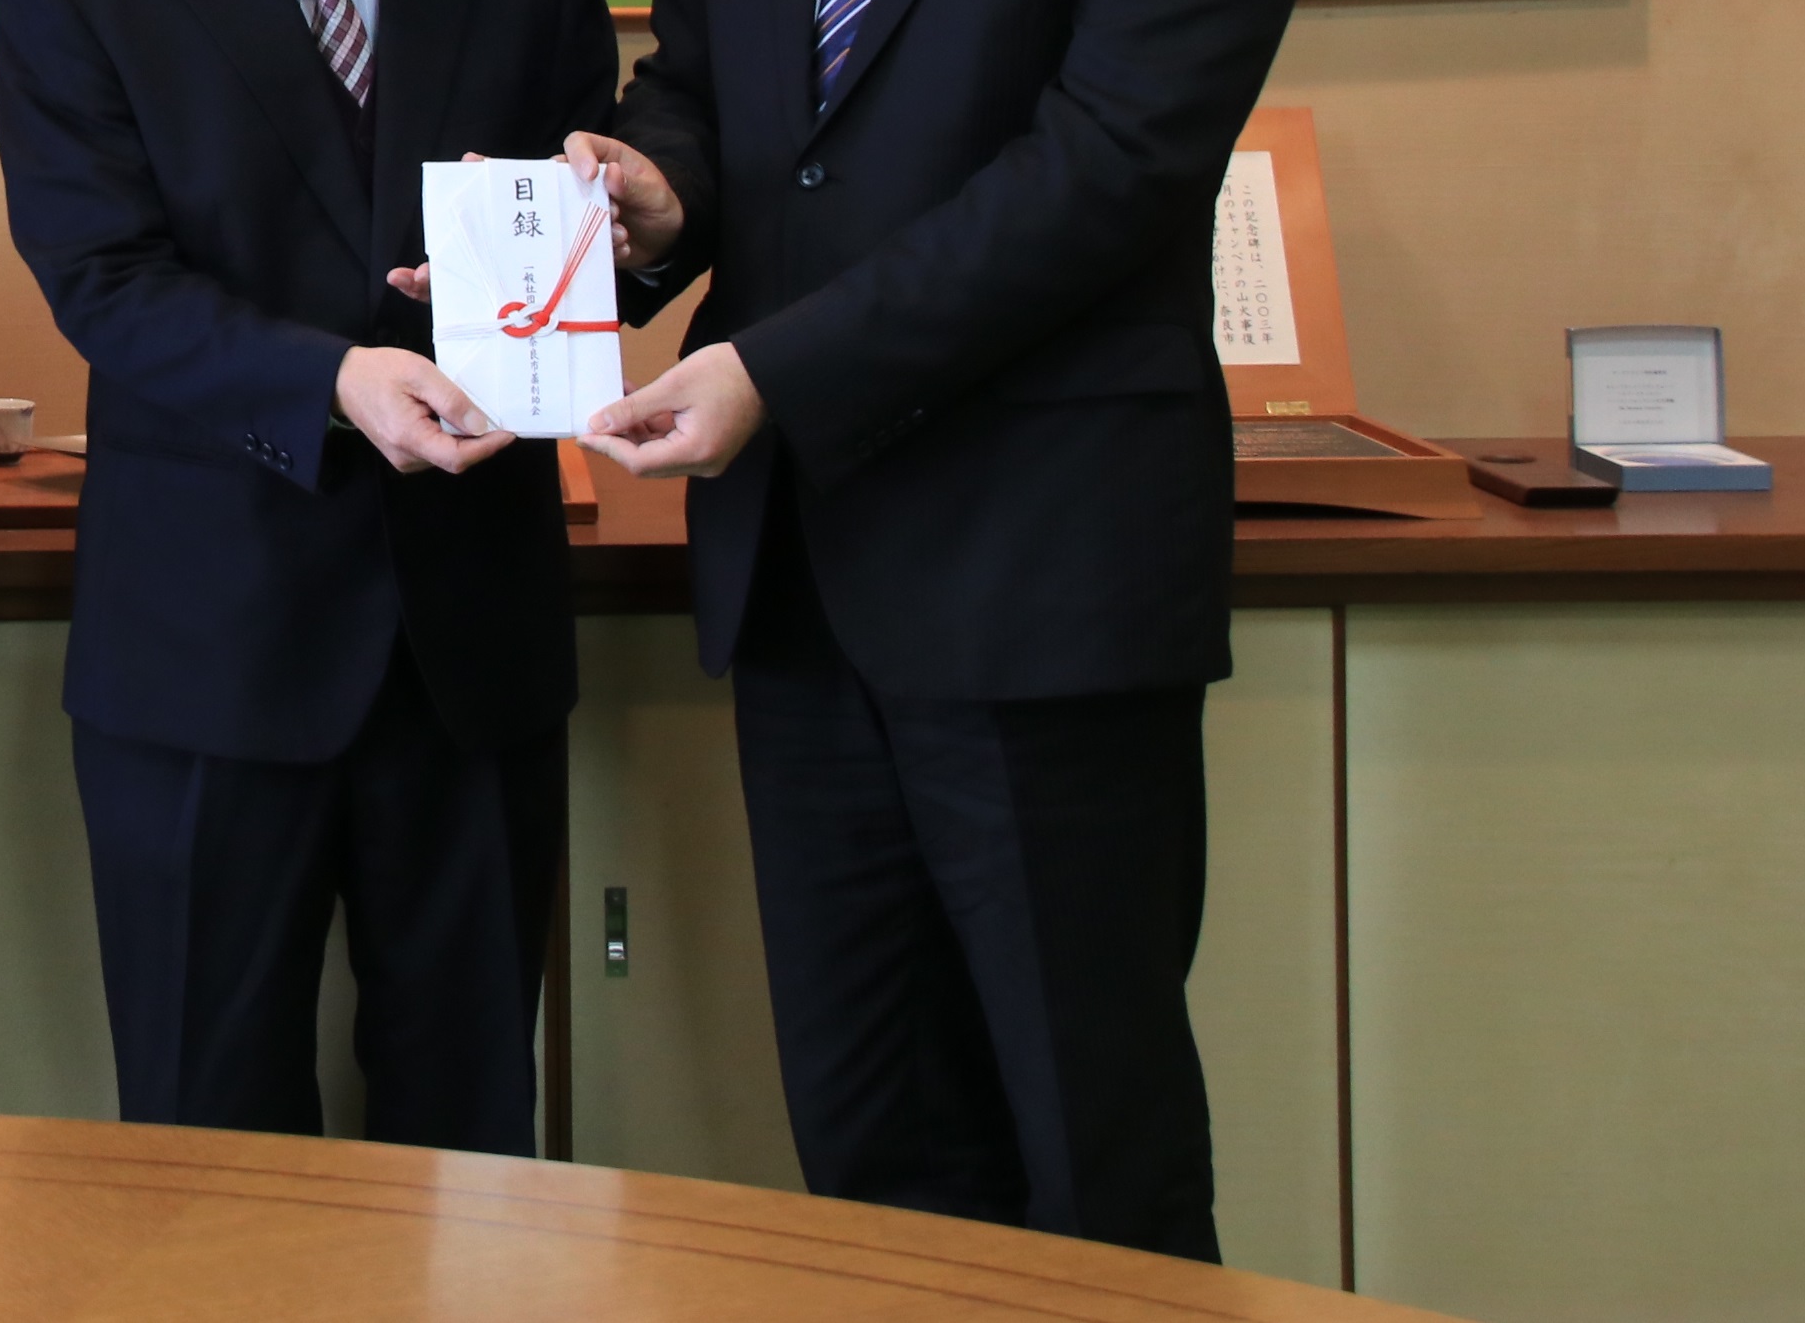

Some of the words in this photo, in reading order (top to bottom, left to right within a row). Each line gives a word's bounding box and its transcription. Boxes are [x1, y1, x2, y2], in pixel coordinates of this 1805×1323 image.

[512, 178, 543, 237] 目録
[522, 265, 537, 304] 一般社団
